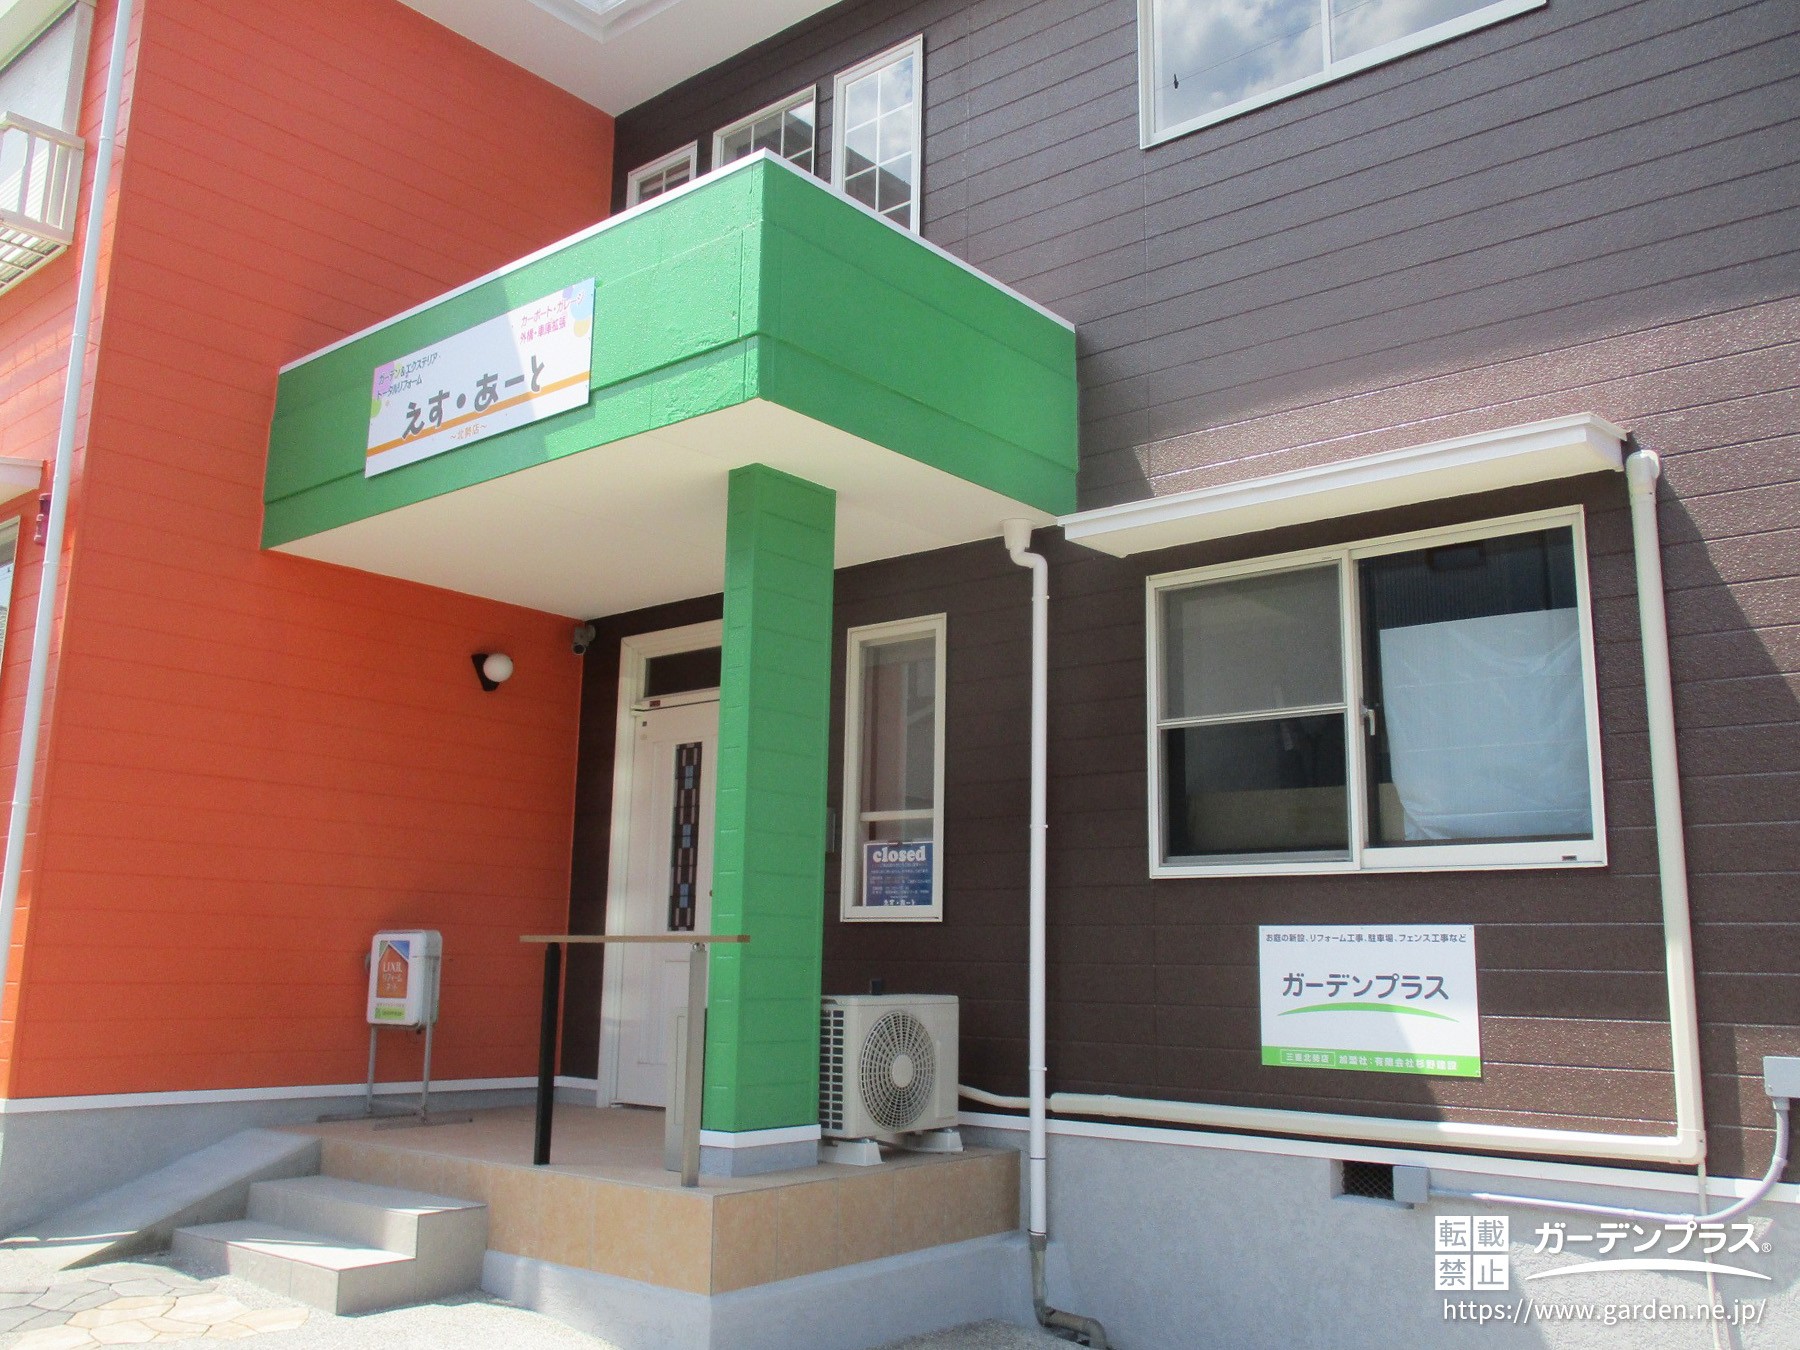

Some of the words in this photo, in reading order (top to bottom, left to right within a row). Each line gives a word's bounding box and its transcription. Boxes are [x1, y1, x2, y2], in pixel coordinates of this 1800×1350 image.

[402, 355, 545, 440] えす・あーと
[872, 845, 927, 863] closed
[1282, 972, 1450, 1000] ガーデンプラス
